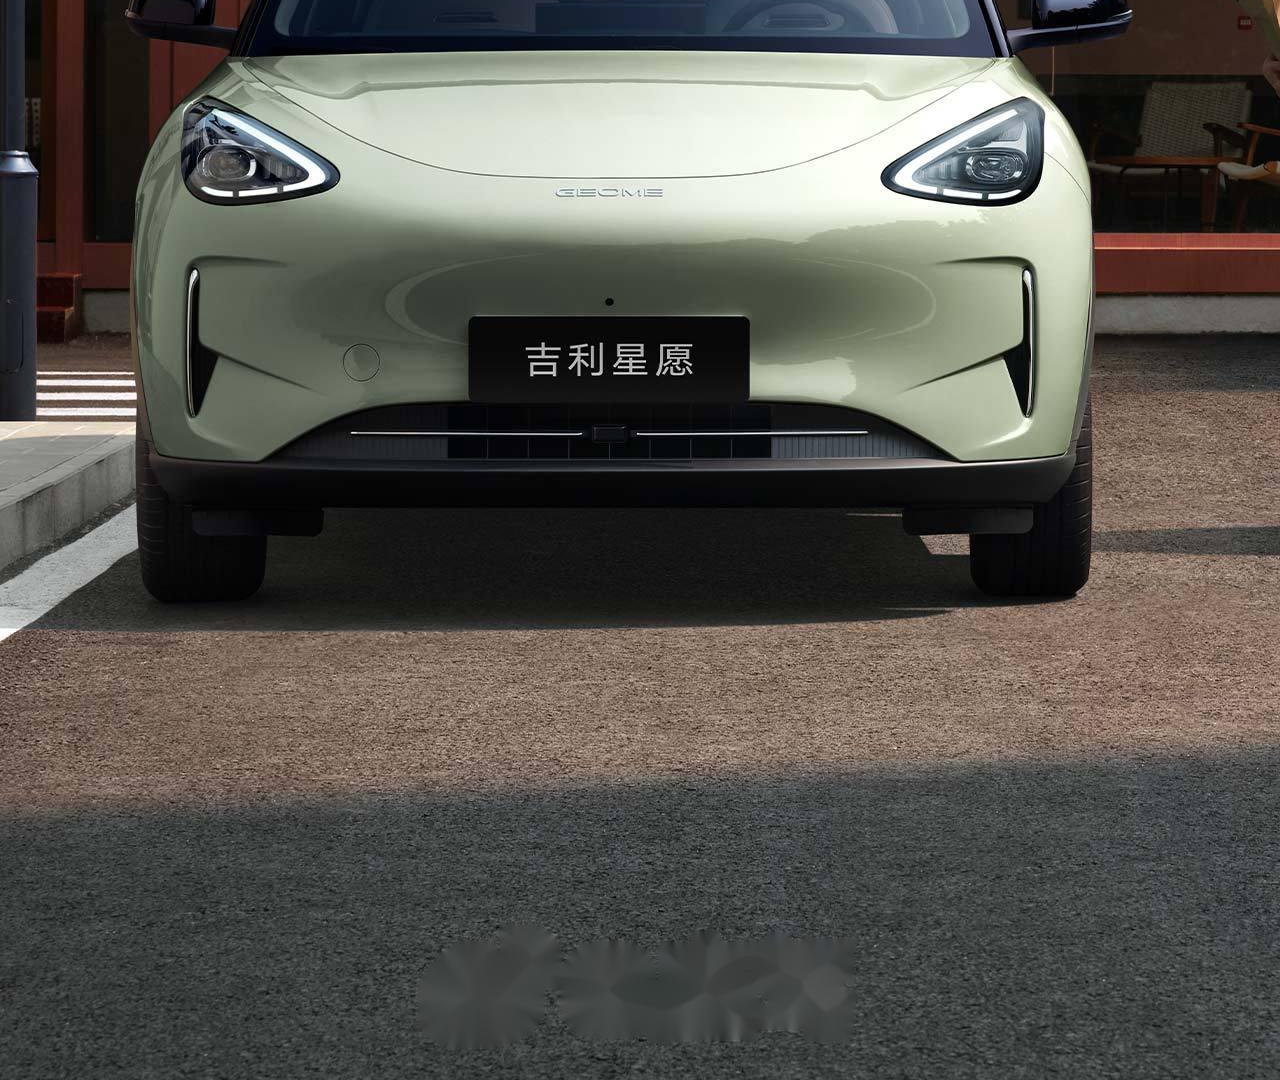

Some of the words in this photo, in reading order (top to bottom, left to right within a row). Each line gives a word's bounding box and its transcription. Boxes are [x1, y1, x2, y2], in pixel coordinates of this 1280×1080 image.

[554, 187, 663, 198] GEOME
[525, 341, 694, 377] 吉利星愿
